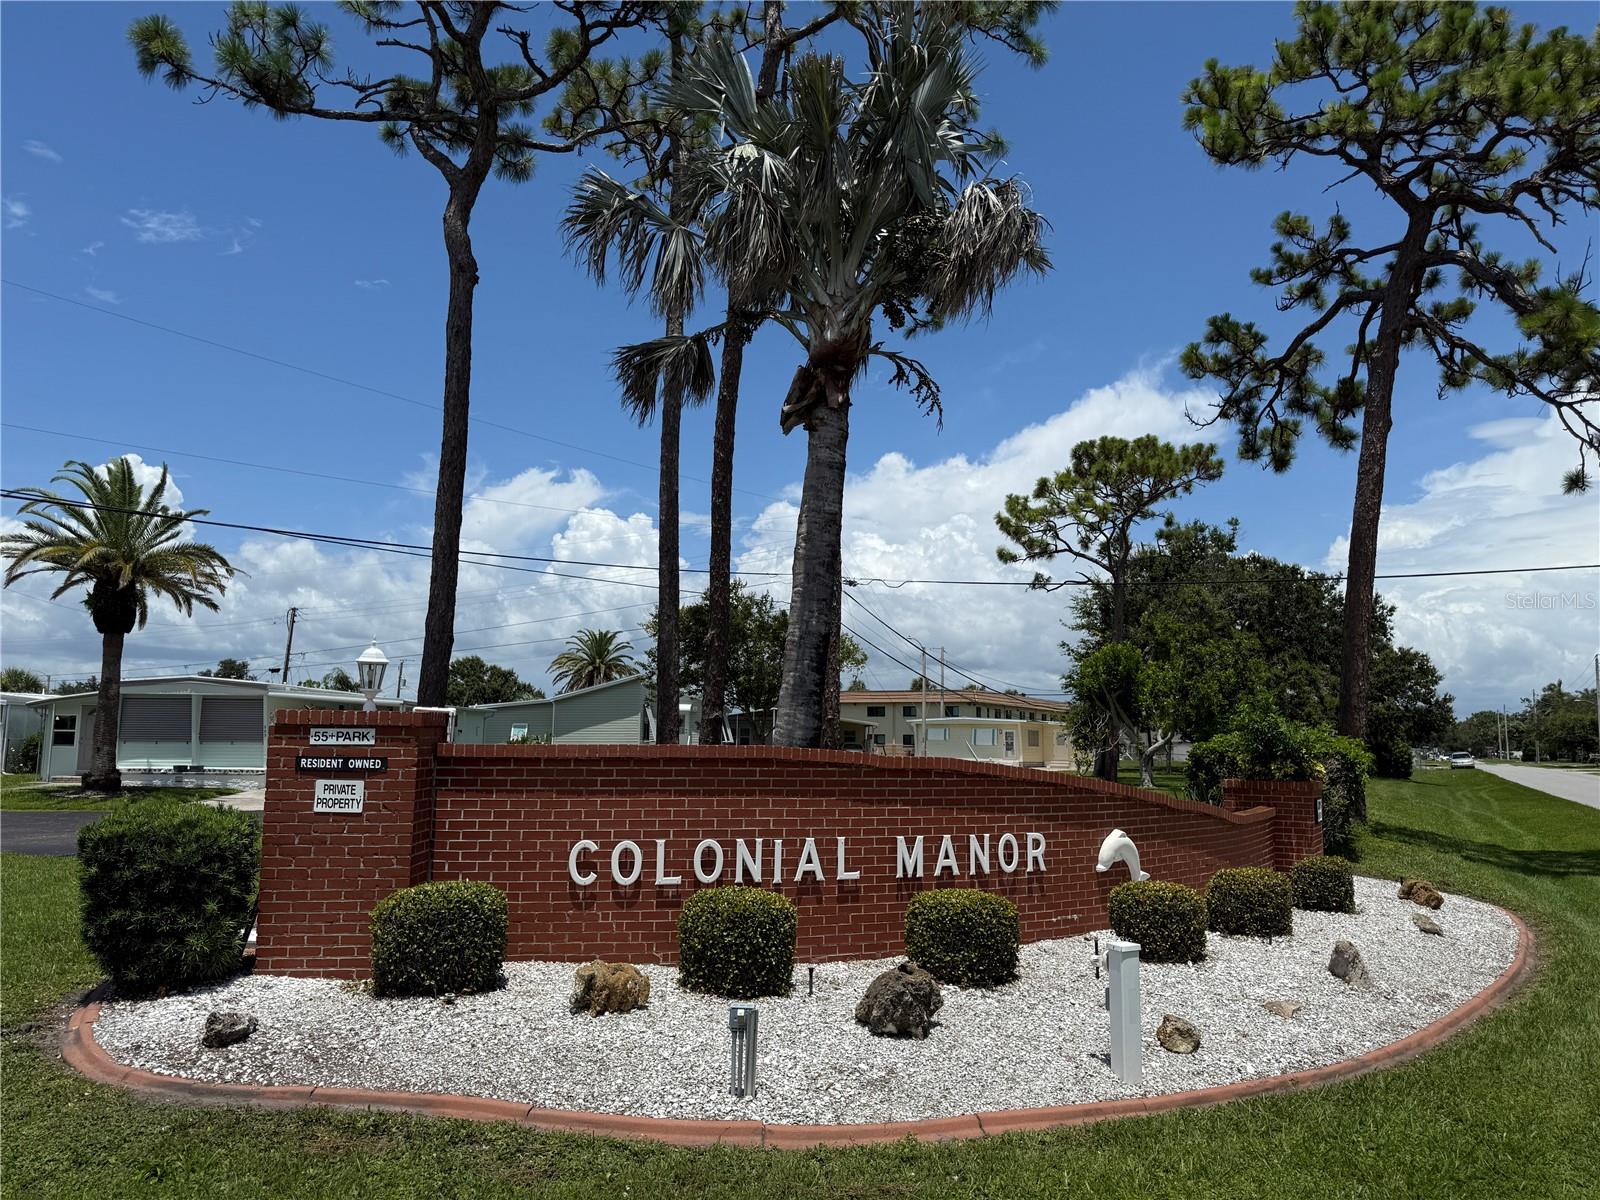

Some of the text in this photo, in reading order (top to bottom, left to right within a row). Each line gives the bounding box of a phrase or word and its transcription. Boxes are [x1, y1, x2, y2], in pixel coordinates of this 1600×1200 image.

[300, 758, 382, 769] RESIDENT OWNED
[323, 783, 357, 796] PRIVATE
[315, 797, 362, 809] PROPERTY
[568, 832, 1048, 886] COLONIAL MANOR
